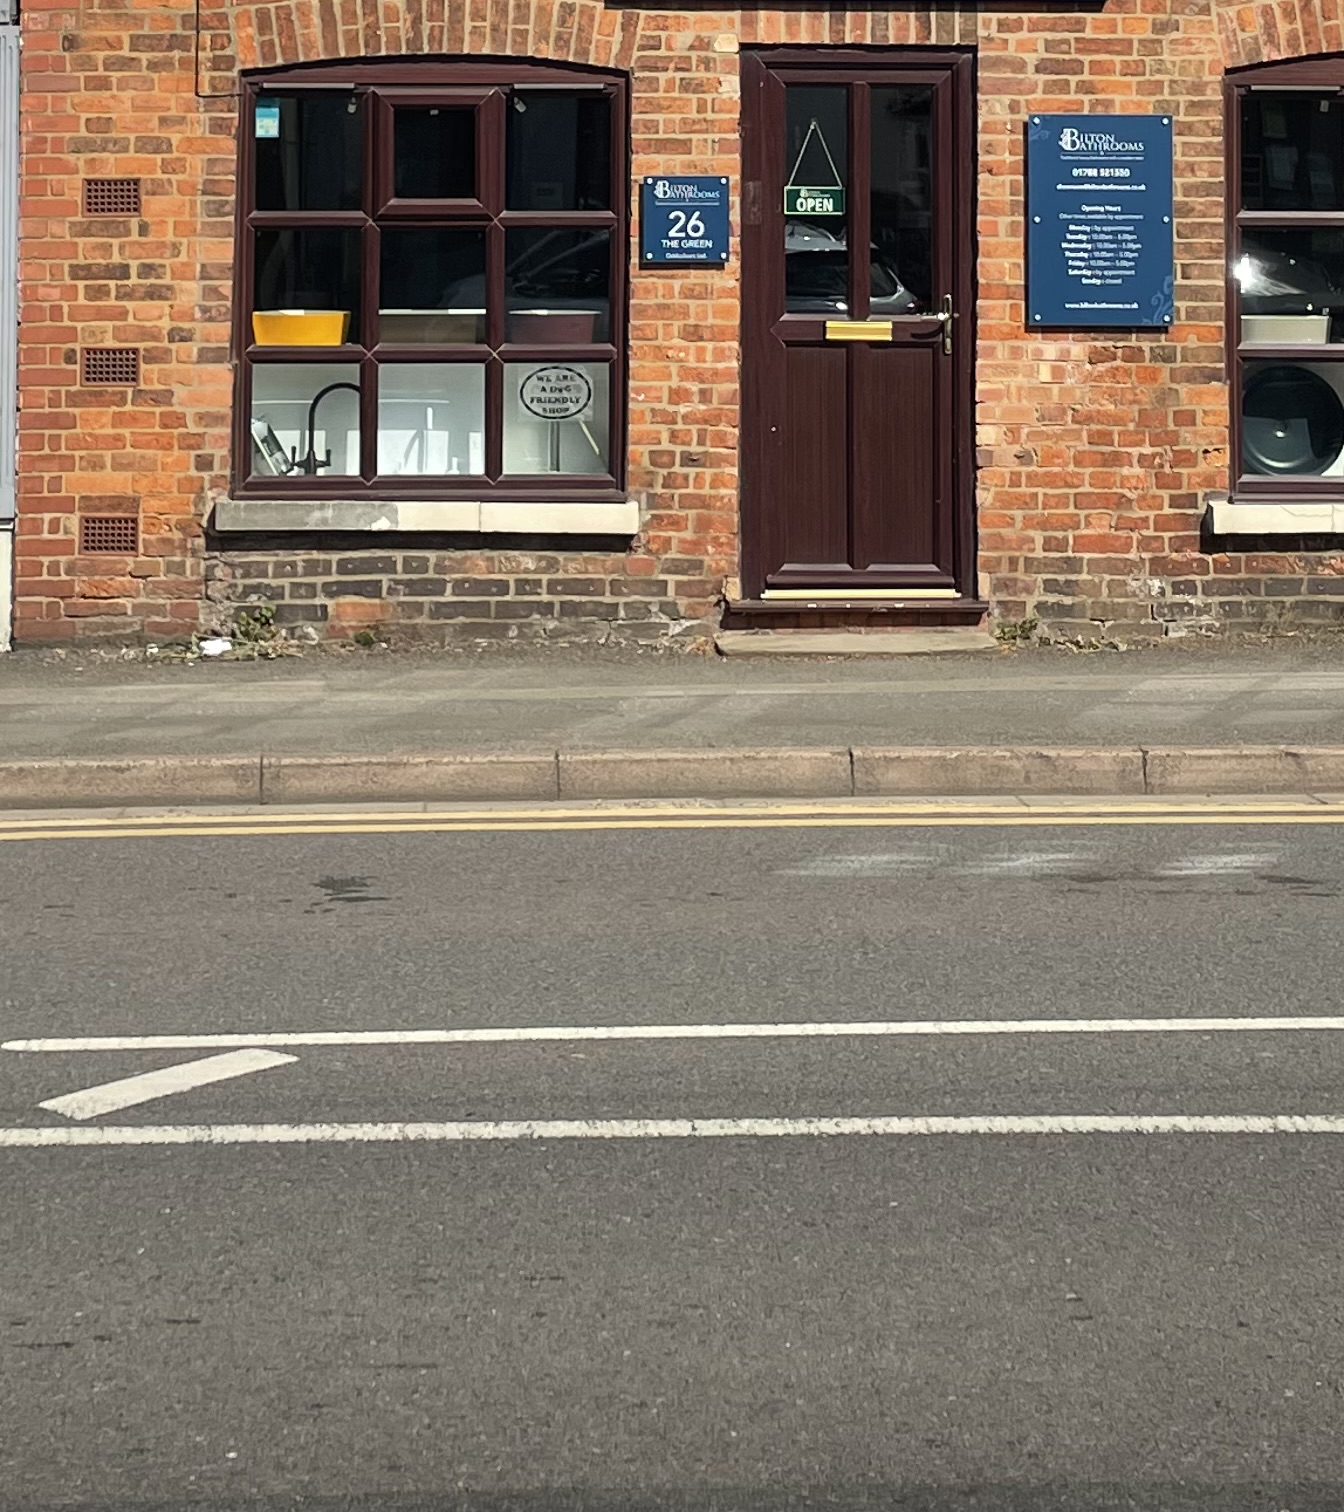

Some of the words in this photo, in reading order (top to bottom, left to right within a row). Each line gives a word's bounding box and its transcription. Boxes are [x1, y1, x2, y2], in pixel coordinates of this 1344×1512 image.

[1062, 128, 1115, 151] BILTON
[796, 197, 834, 212] OPEN
[668, 210, 705, 238] 26
[661, 239, 679, 249] THE
[681, 239, 713, 249] GREEN
